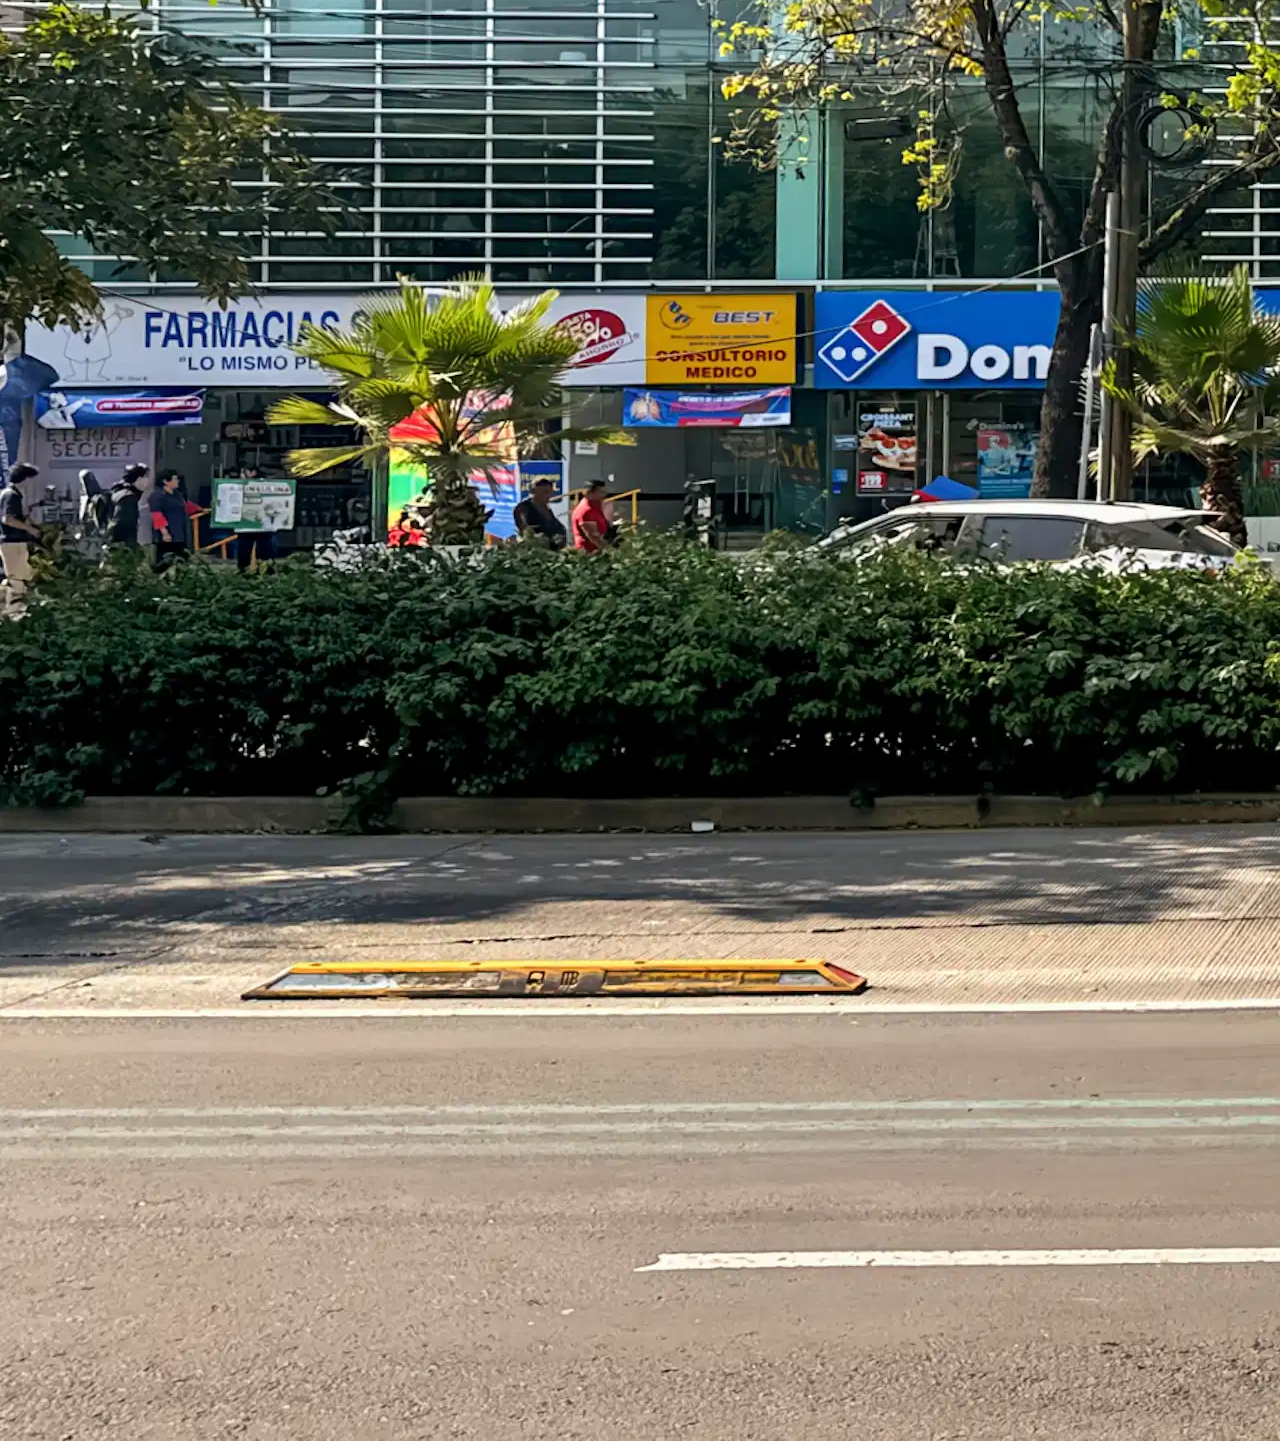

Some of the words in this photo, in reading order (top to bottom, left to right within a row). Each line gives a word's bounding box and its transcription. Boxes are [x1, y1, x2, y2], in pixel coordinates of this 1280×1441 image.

[711, 310, 776, 324] BEST
[144, 310, 340, 348] FARMACIAS
[655, 349, 787, 362] CONSULTORIO
[221, 356, 288, 371] MISMO
[685, 366, 758, 379] MEDICO
[52, 442, 134, 458] SECRET
